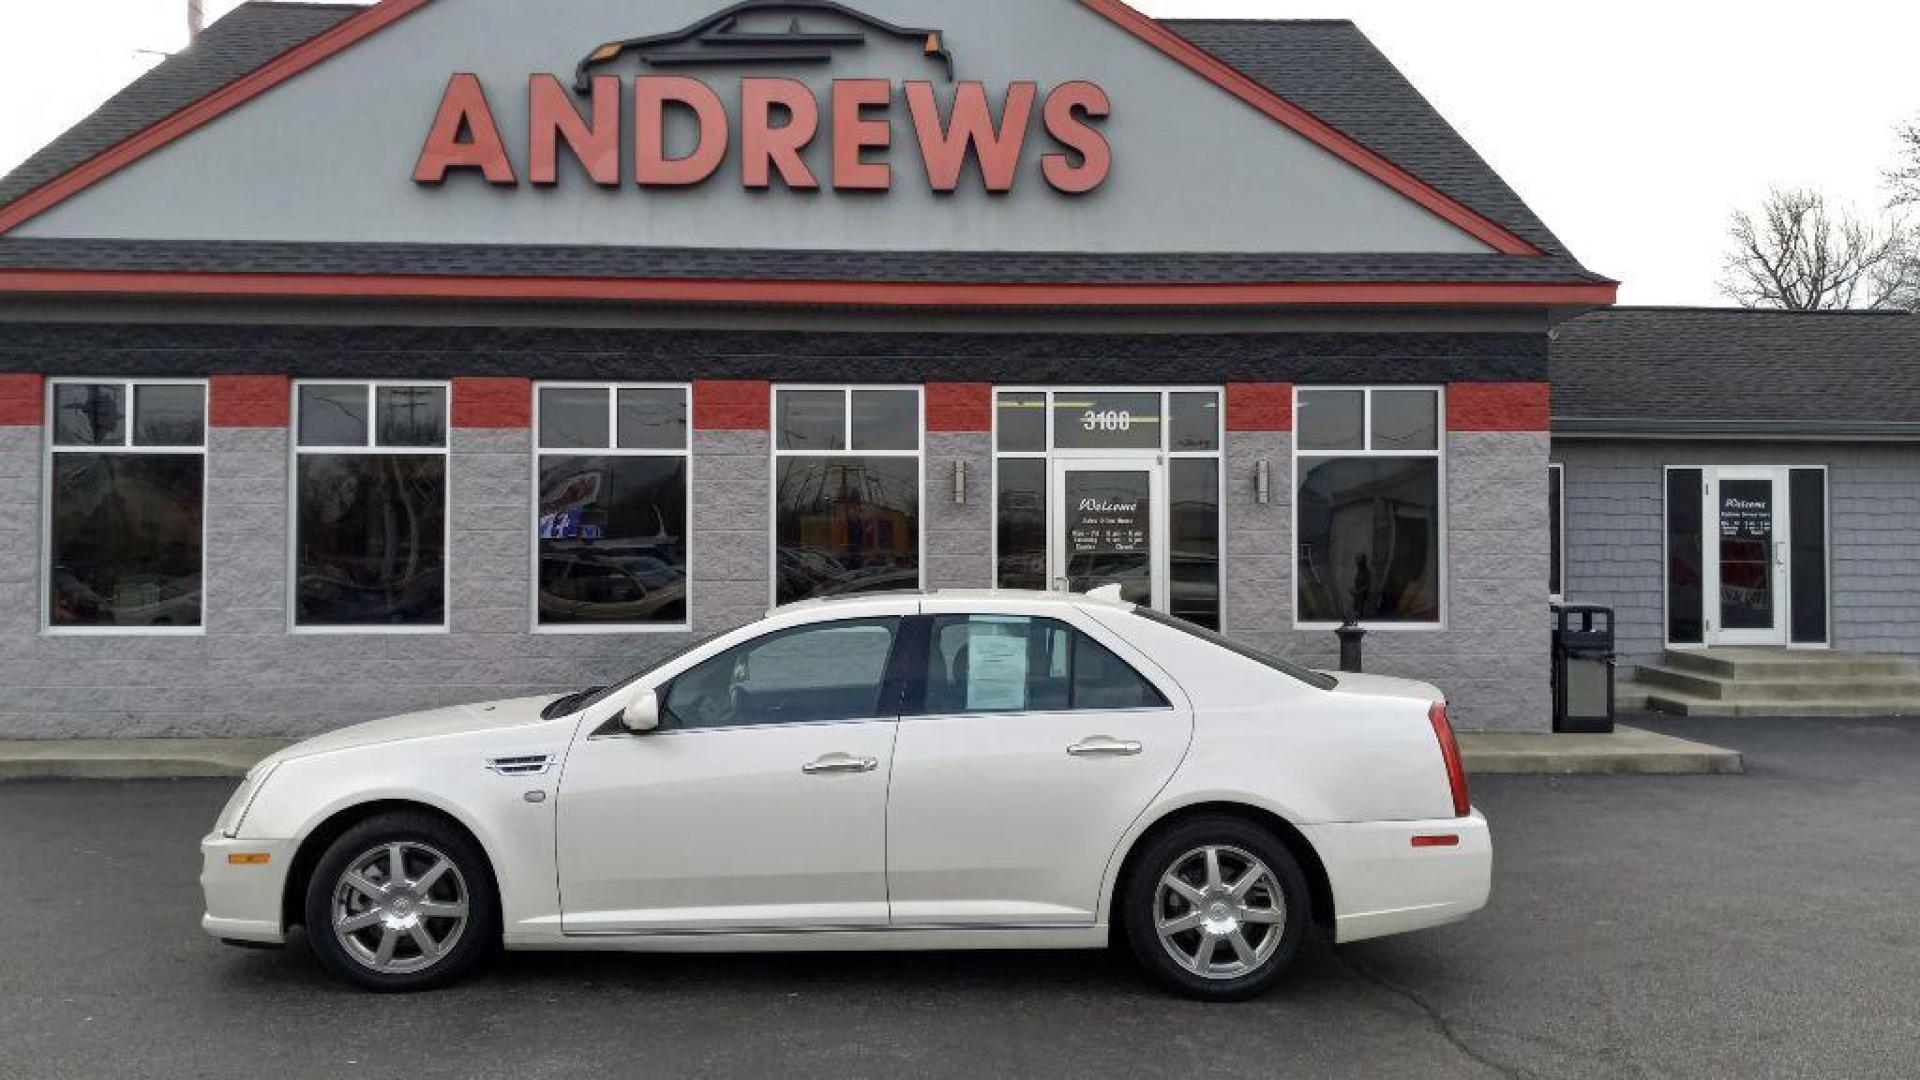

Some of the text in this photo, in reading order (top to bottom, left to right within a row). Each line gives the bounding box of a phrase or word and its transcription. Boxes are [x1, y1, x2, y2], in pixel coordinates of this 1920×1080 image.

[411, 72, 1112, 194] ANDREWS
[1083, 410, 1130, 431] 3100
[1076, 498, 1137, 512] Welcome
